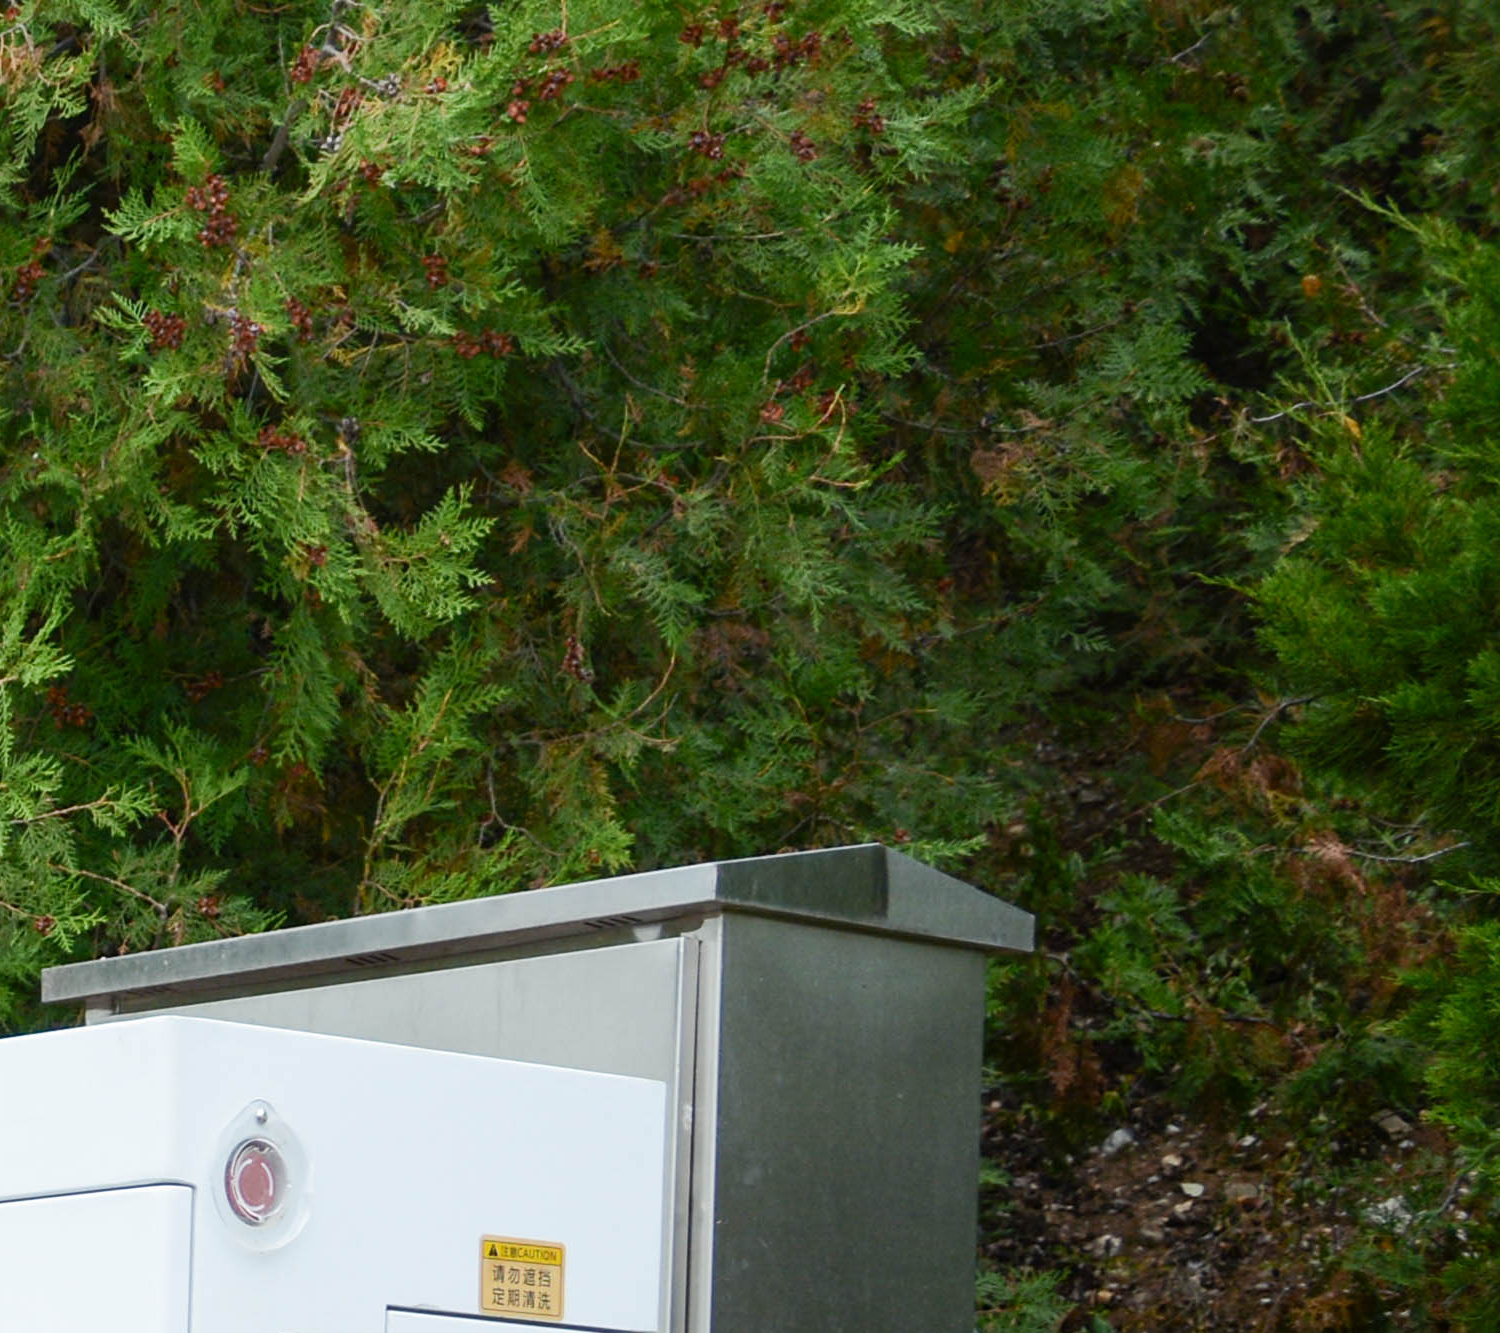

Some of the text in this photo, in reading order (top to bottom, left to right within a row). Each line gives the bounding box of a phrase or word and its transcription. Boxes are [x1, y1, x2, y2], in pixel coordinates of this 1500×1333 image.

[492, 1264, 551, 1287] 请勿遮挡
[492, 1288, 551, 1310] 定期清洗
